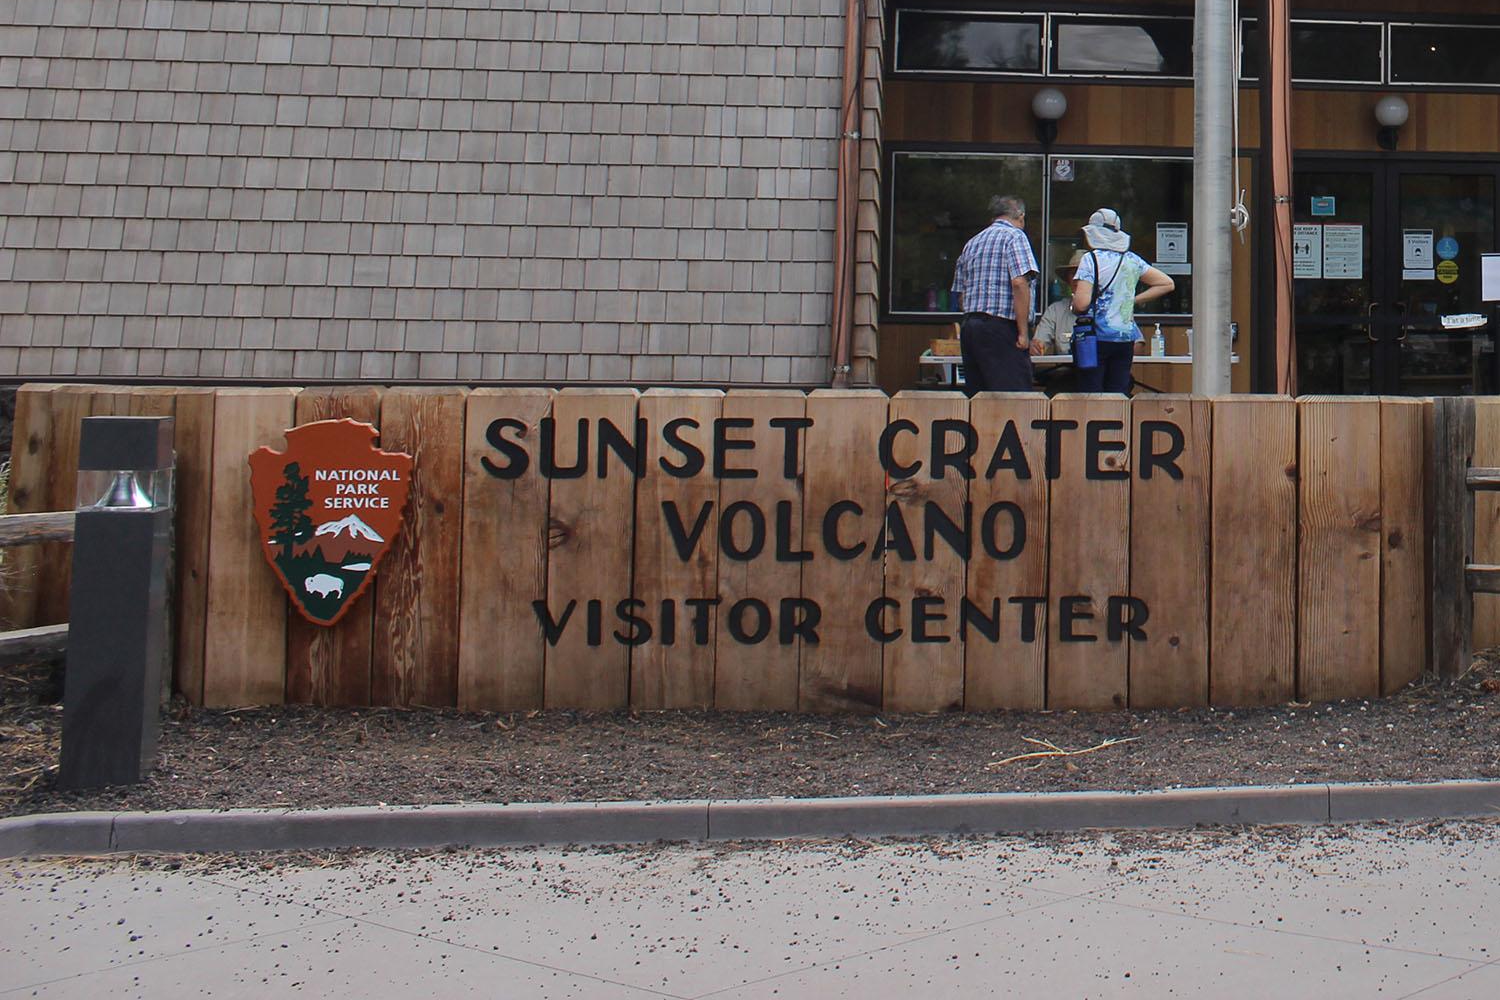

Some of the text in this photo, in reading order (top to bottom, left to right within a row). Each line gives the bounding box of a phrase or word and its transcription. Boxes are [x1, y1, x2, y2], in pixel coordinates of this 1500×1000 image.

[480, 417, 1185, 481] SUNSET CRATER
[315, 469, 401, 481] NATIONAL
[336, 483, 379, 495] PARK
[324, 497, 389, 509] SERVICE
[662, 500, 1027, 562] VOLCANO
[533, 597, 1150, 647] VISITOR CENTER
